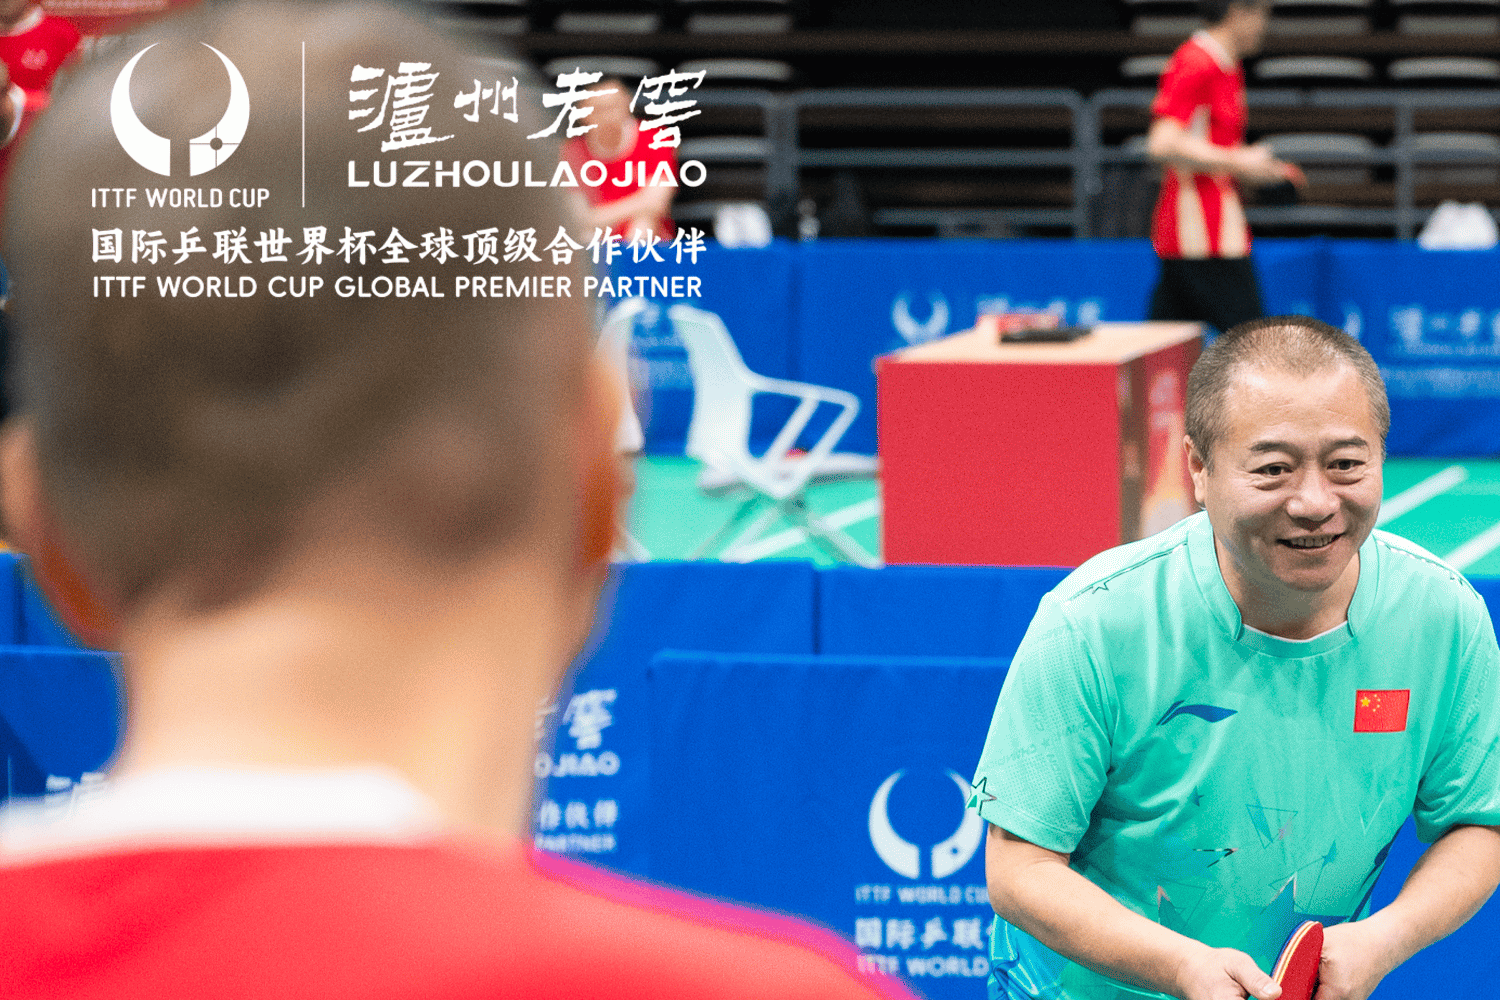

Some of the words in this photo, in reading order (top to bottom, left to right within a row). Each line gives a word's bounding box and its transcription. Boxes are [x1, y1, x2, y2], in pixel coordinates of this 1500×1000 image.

[855, 917, 992, 949] 国际乒联
[906, 955, 990, 977] WORLD
